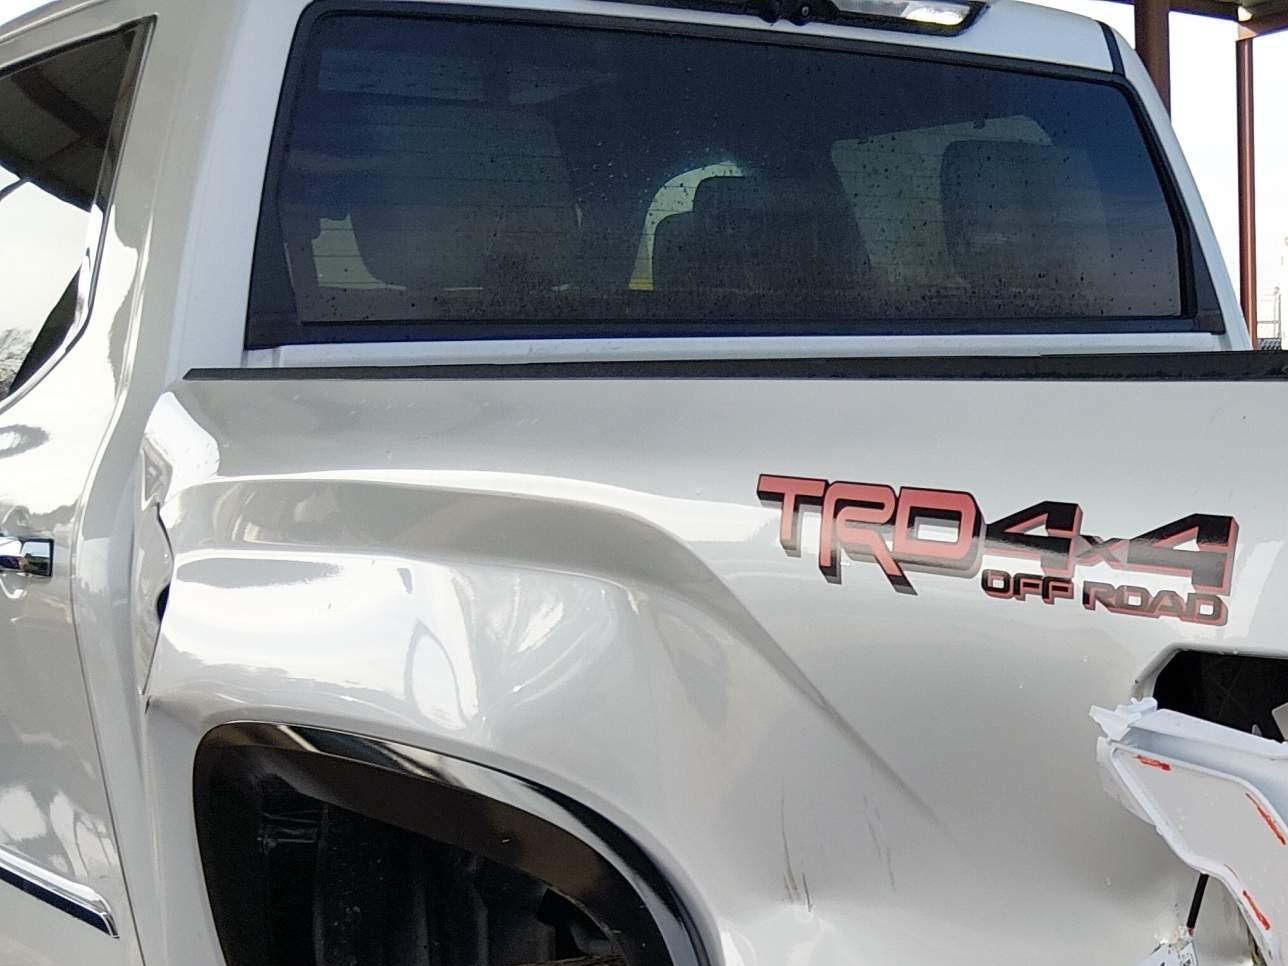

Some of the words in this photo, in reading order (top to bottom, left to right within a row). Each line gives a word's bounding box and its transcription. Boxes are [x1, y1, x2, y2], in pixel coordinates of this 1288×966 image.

[756, 473, 985, 596] TRD
[980, 568, 1075, 605] OFF
[1081, 580, 1229, 627] ROAD
